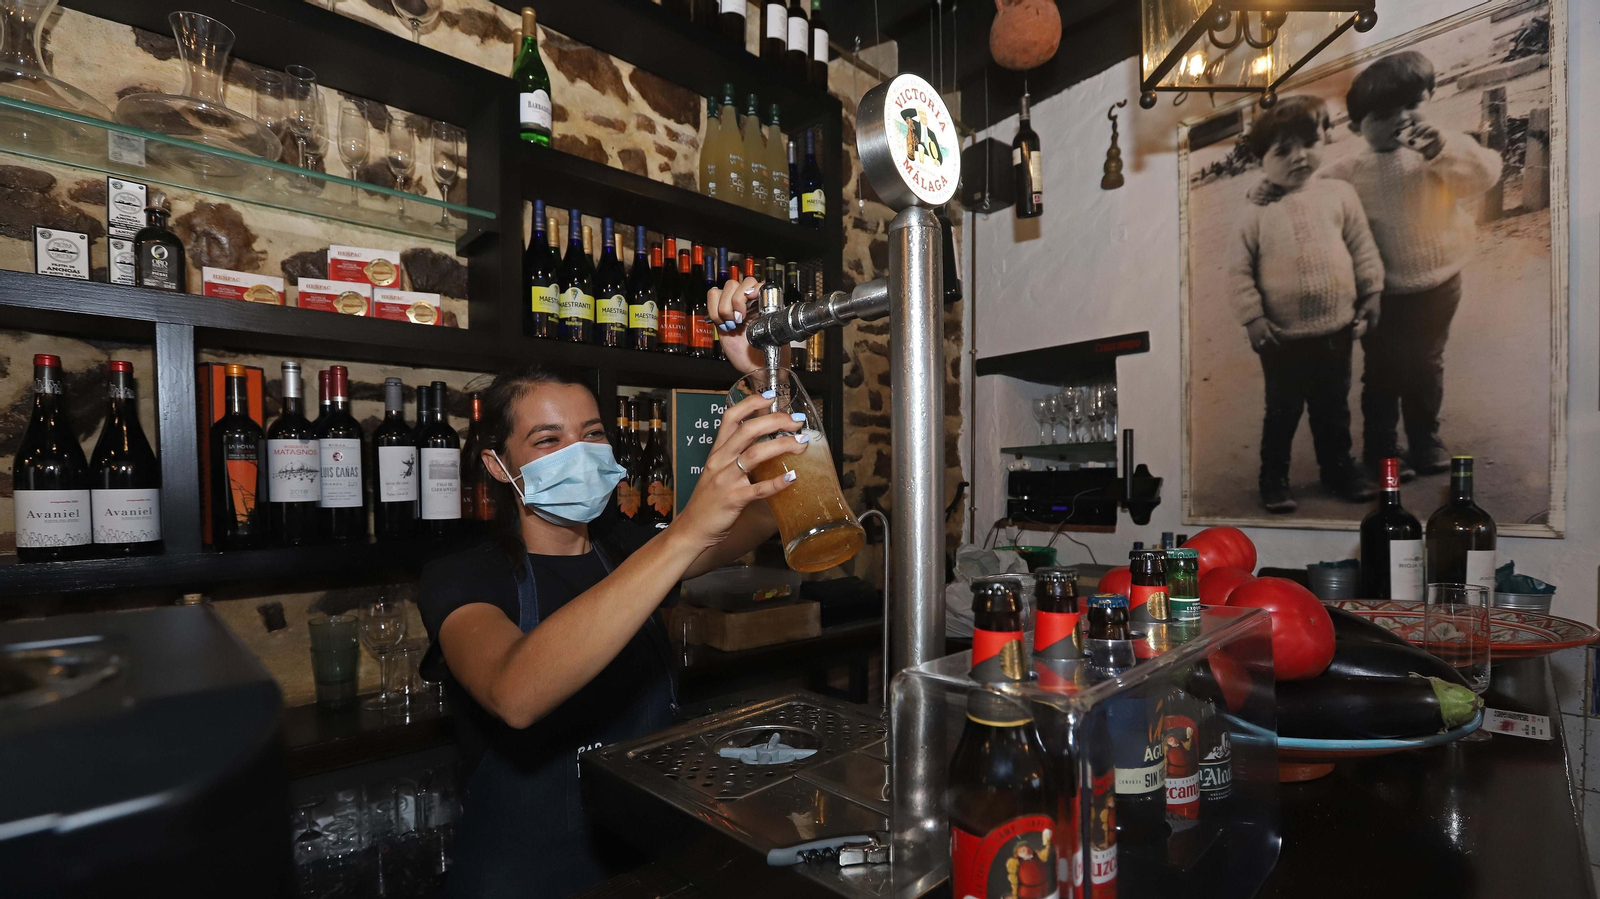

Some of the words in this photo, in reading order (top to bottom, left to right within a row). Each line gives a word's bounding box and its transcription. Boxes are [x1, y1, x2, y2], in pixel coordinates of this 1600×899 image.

[895, 88, 947, 132] VICTORIA
[903, 158, 948, 192] MÁLAGA
[47, 266, 81, 274] ANCHOAS
[694, 418, 709, 429] de
[713, 419, 722, 430] P
[686, 435, 694, 447] y
[698, 433, 713, 444] de
[320, 466, 334, 478] LUIS
[335, 465, 359, 478] CAÑAS
[26, 508, 80, 519] Avaniel
[105, 506, 153, 517] Avaniel
[1145, 771, 1158, 788] SIN
